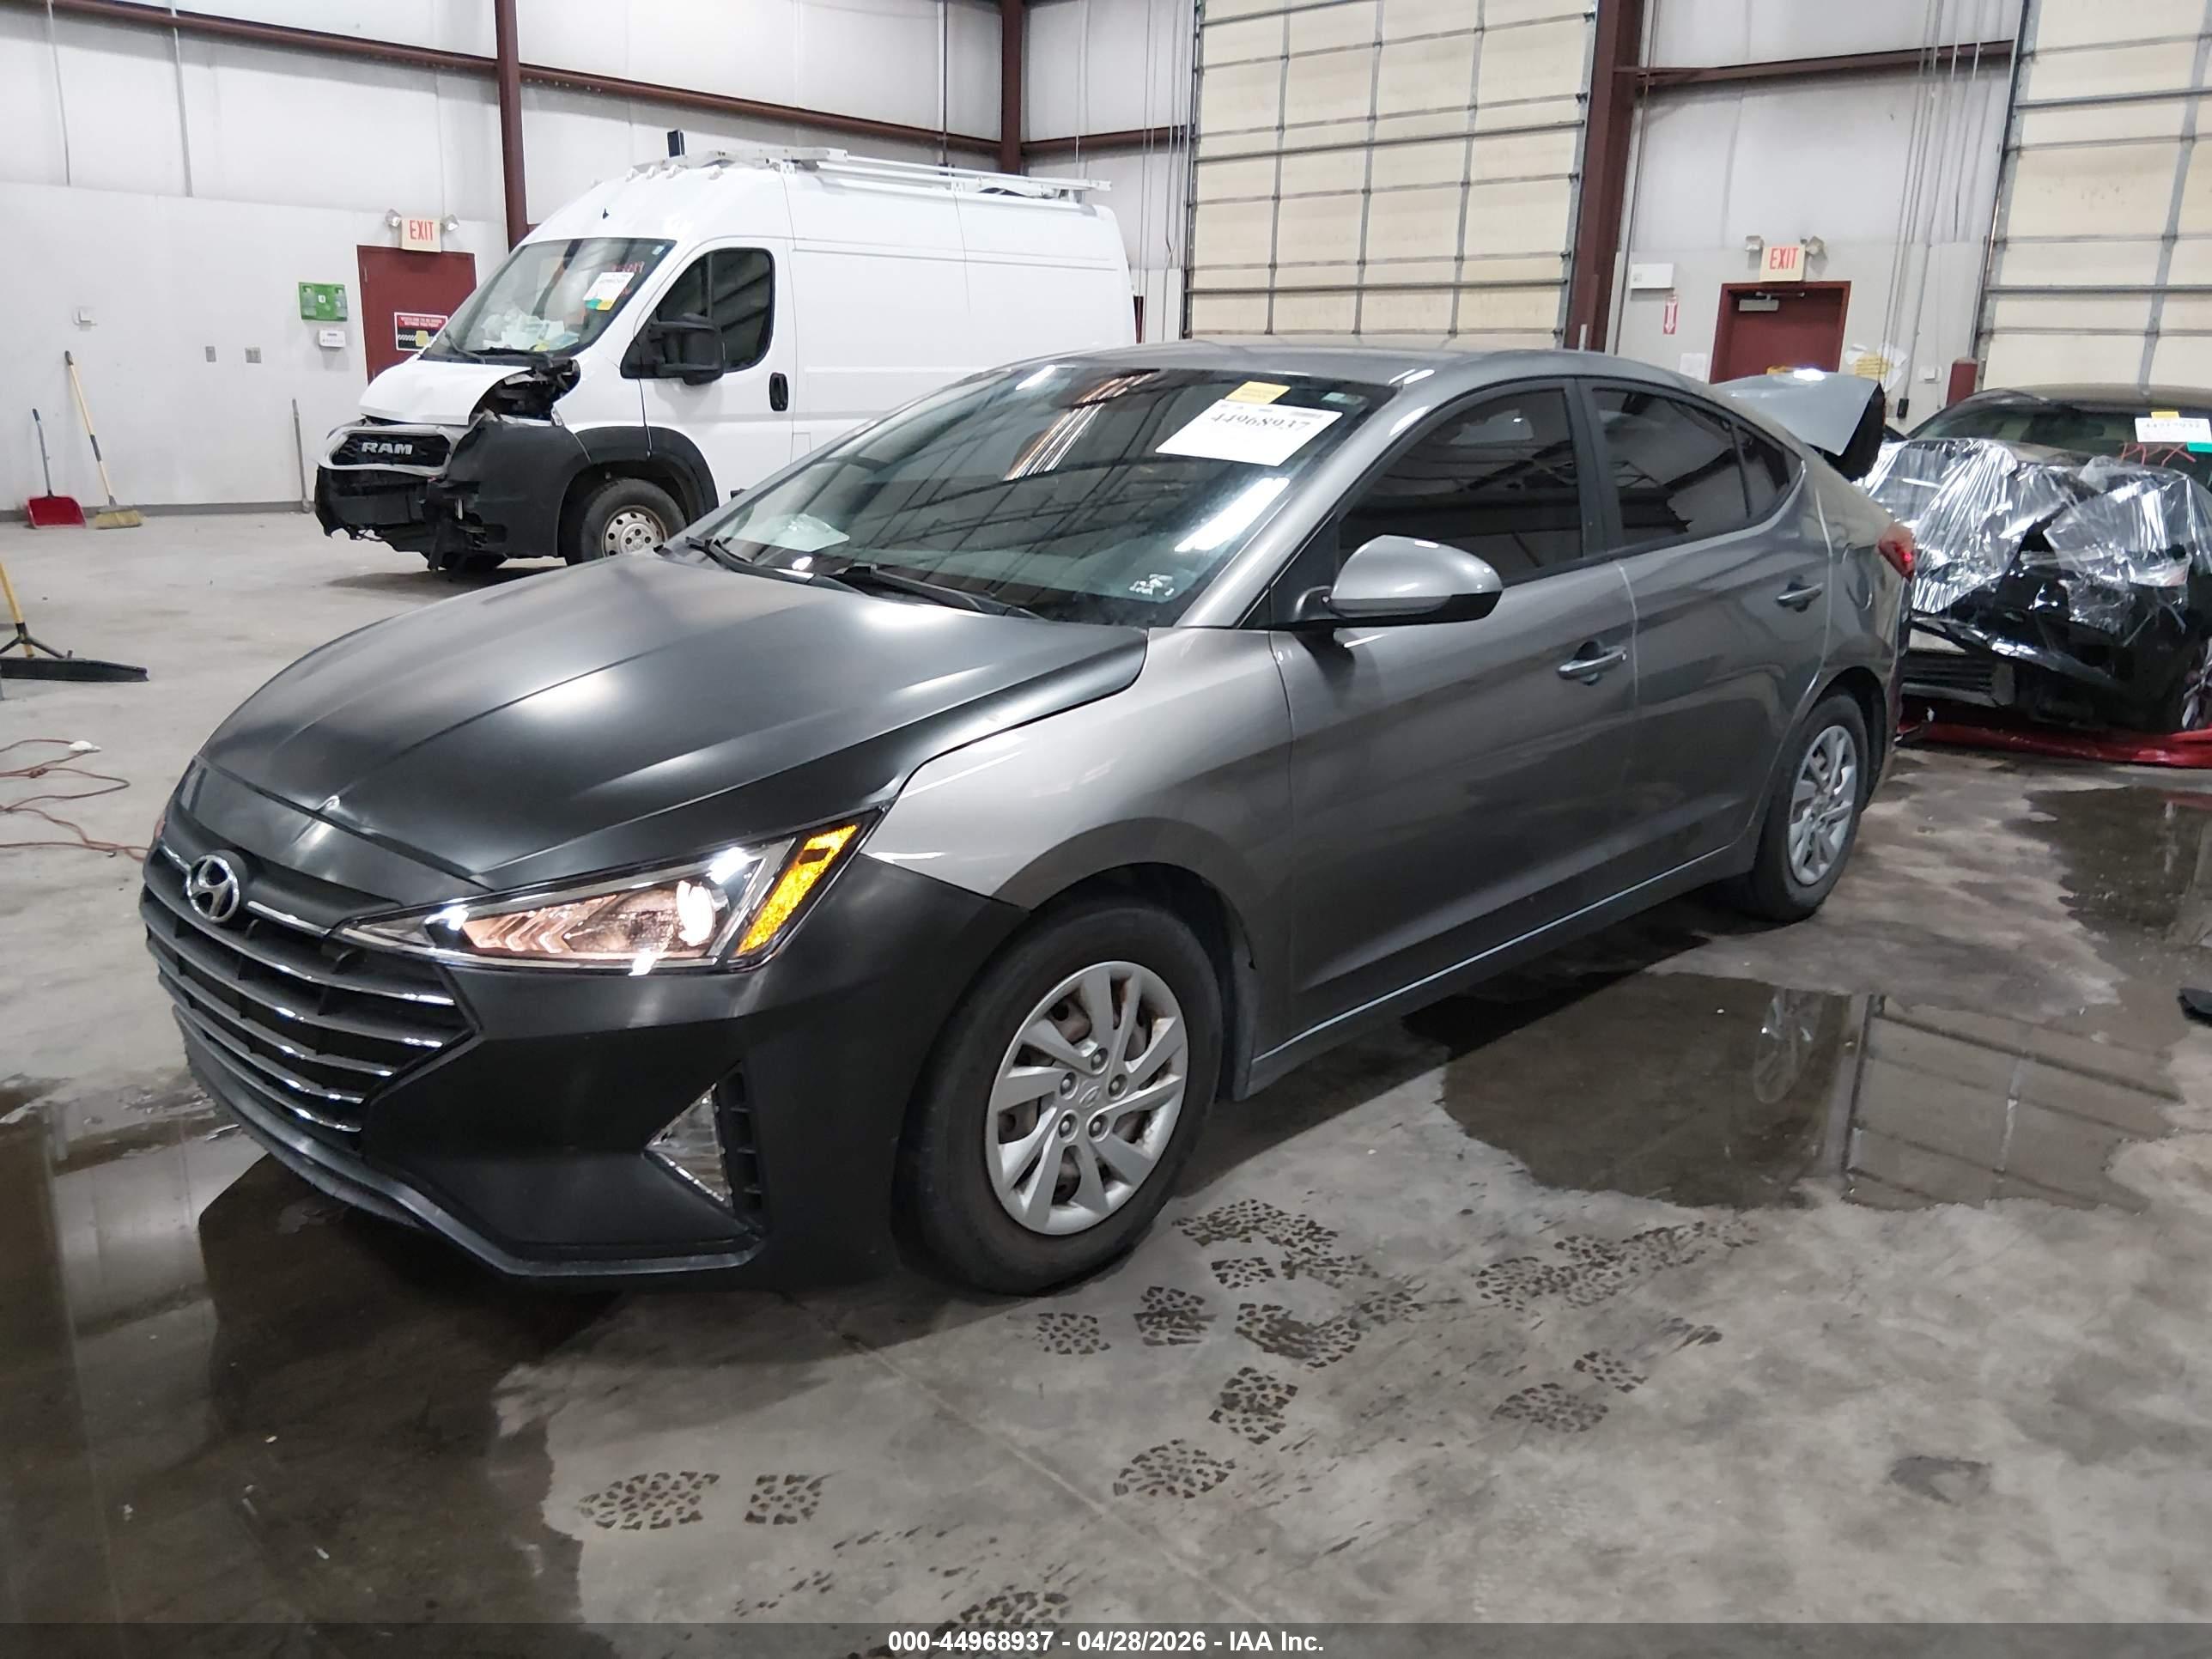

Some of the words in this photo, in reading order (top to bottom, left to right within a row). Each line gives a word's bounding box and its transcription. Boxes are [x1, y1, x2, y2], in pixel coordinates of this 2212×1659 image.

[410, 219, 433, 240] EXIT
[1769, 246, 1799, 270] EXIT
[362, 441, 412, 455] RAM
